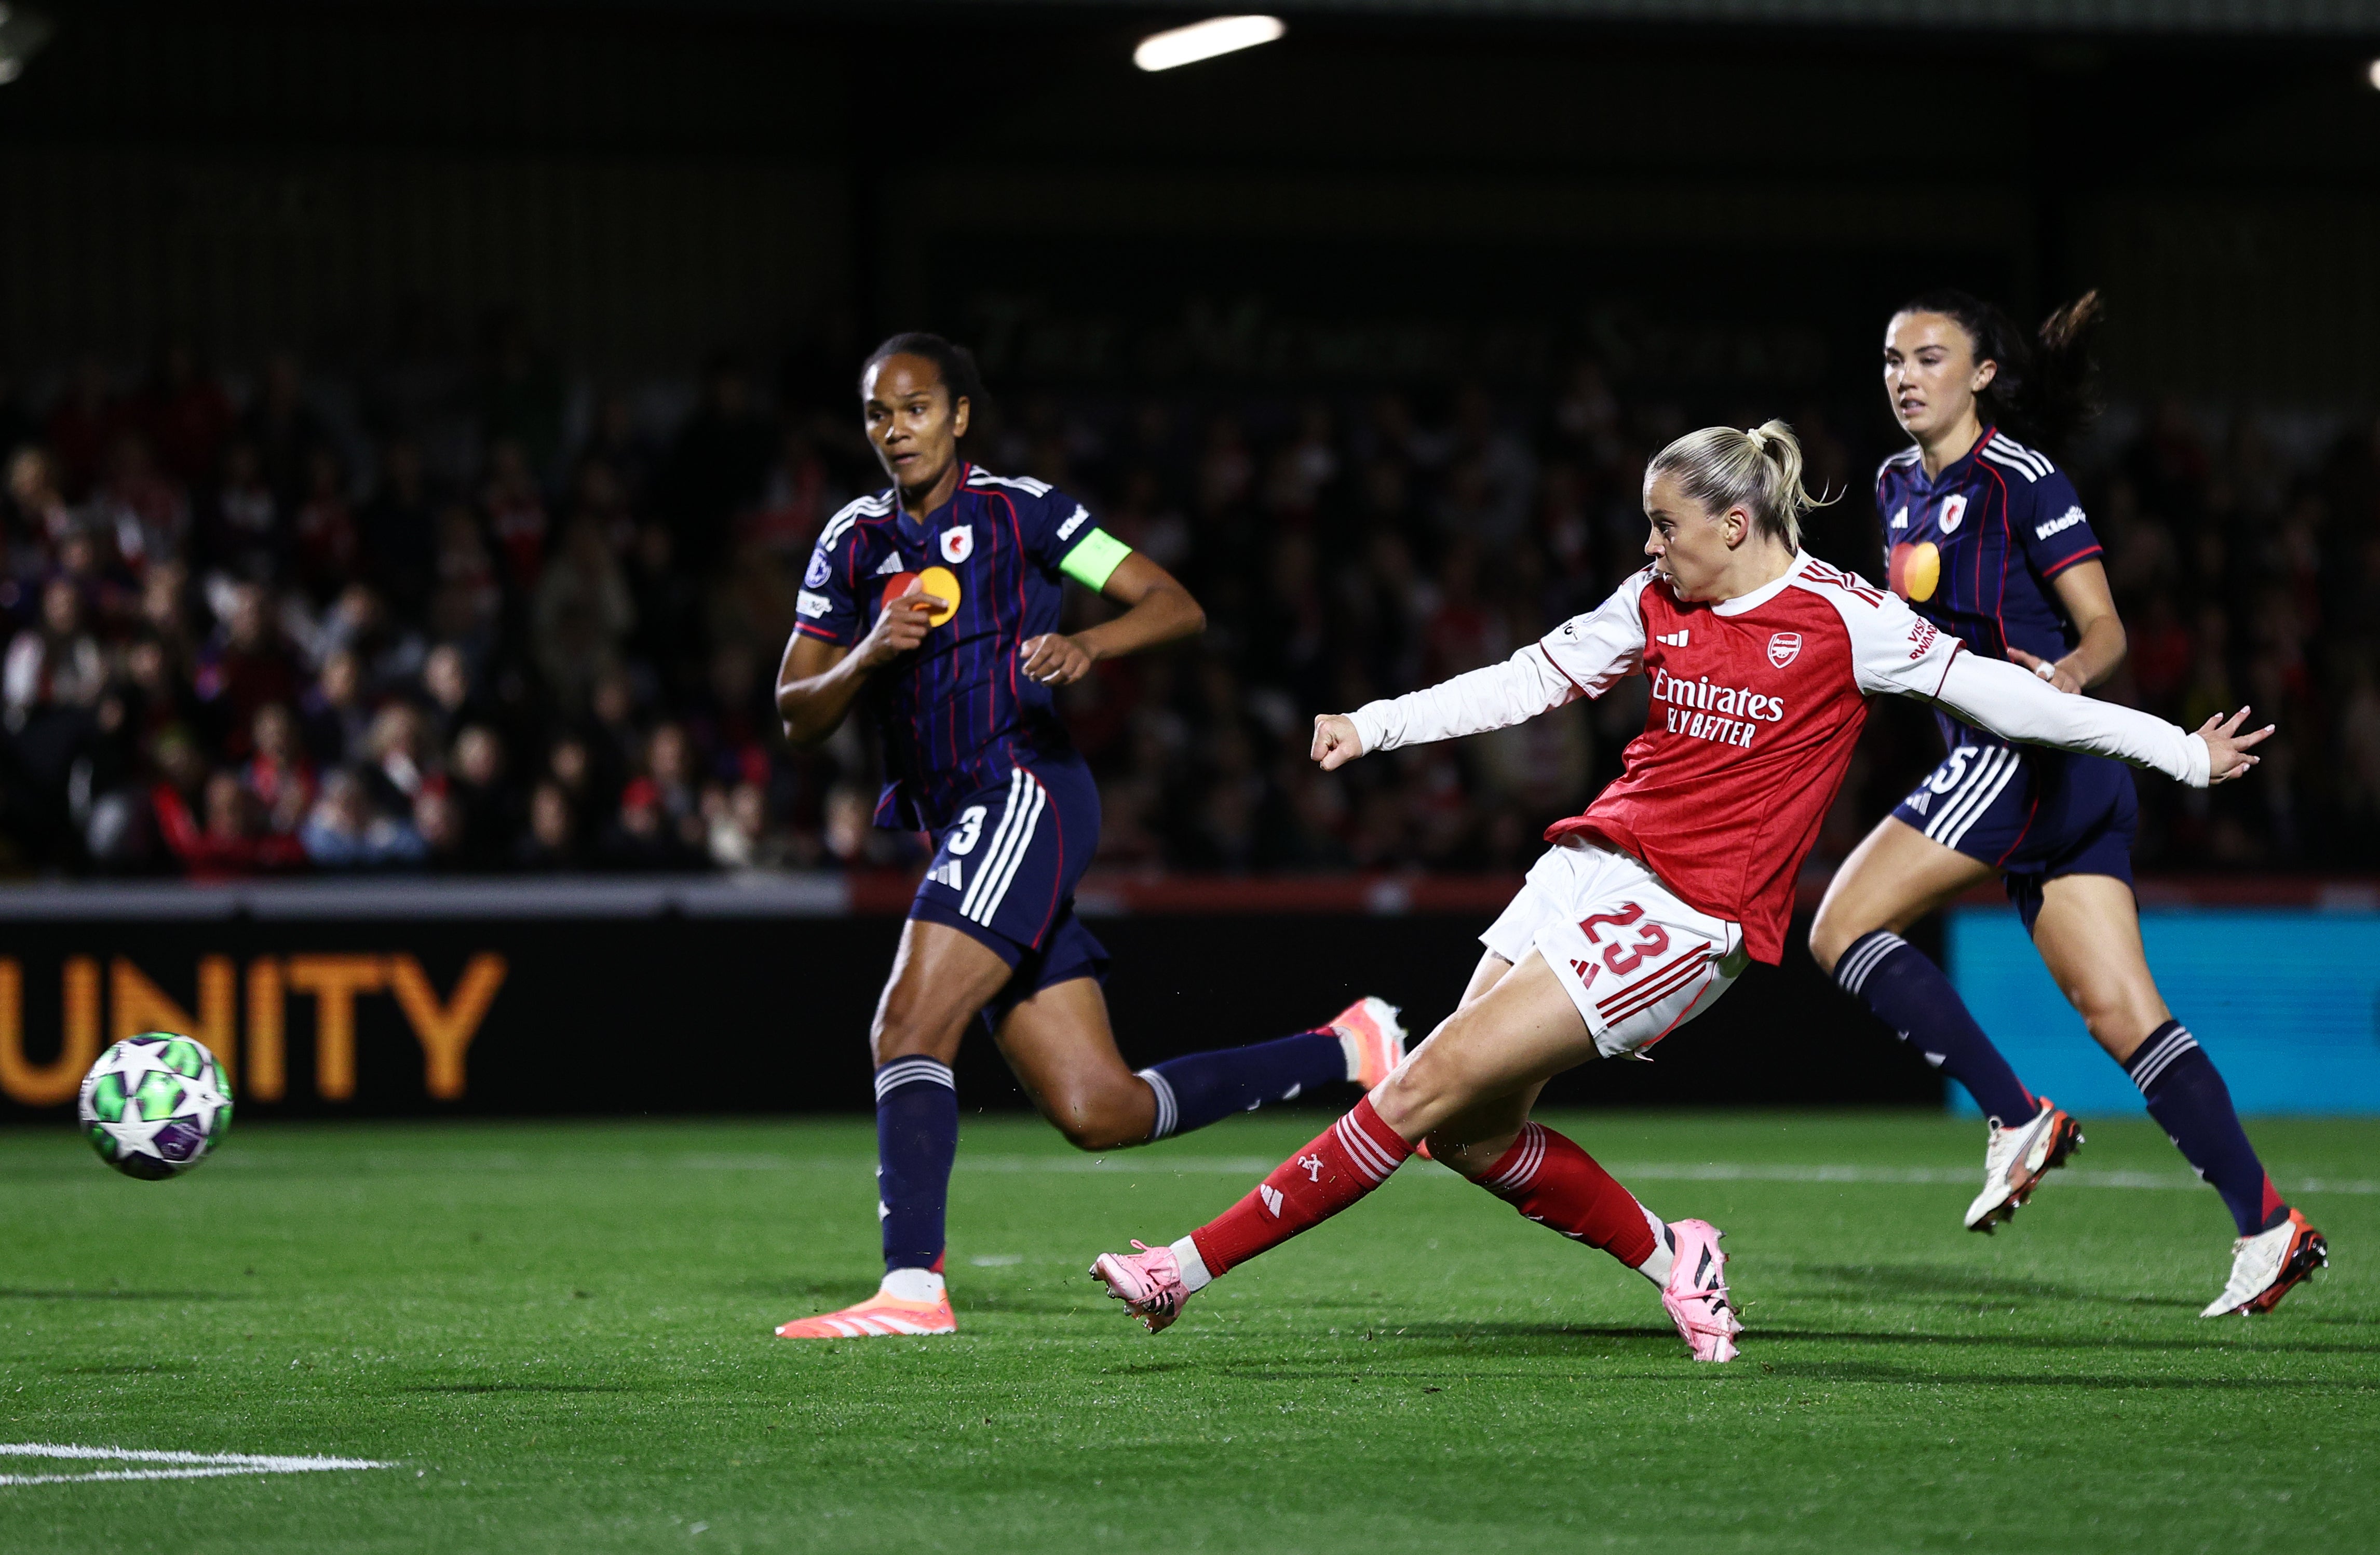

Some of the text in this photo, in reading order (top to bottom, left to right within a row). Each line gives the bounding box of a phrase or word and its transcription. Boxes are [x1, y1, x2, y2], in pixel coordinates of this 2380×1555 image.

[1908, 617, 1926, 642] VISIT
[1653, 667, 1784, 722] Emirates
[1923, 746, 1979, 794] 5
[948, 805, 987, 856] 3
[1577, 901, 1671, 977] 23
[0, 954, 508, 1104] UNITY
